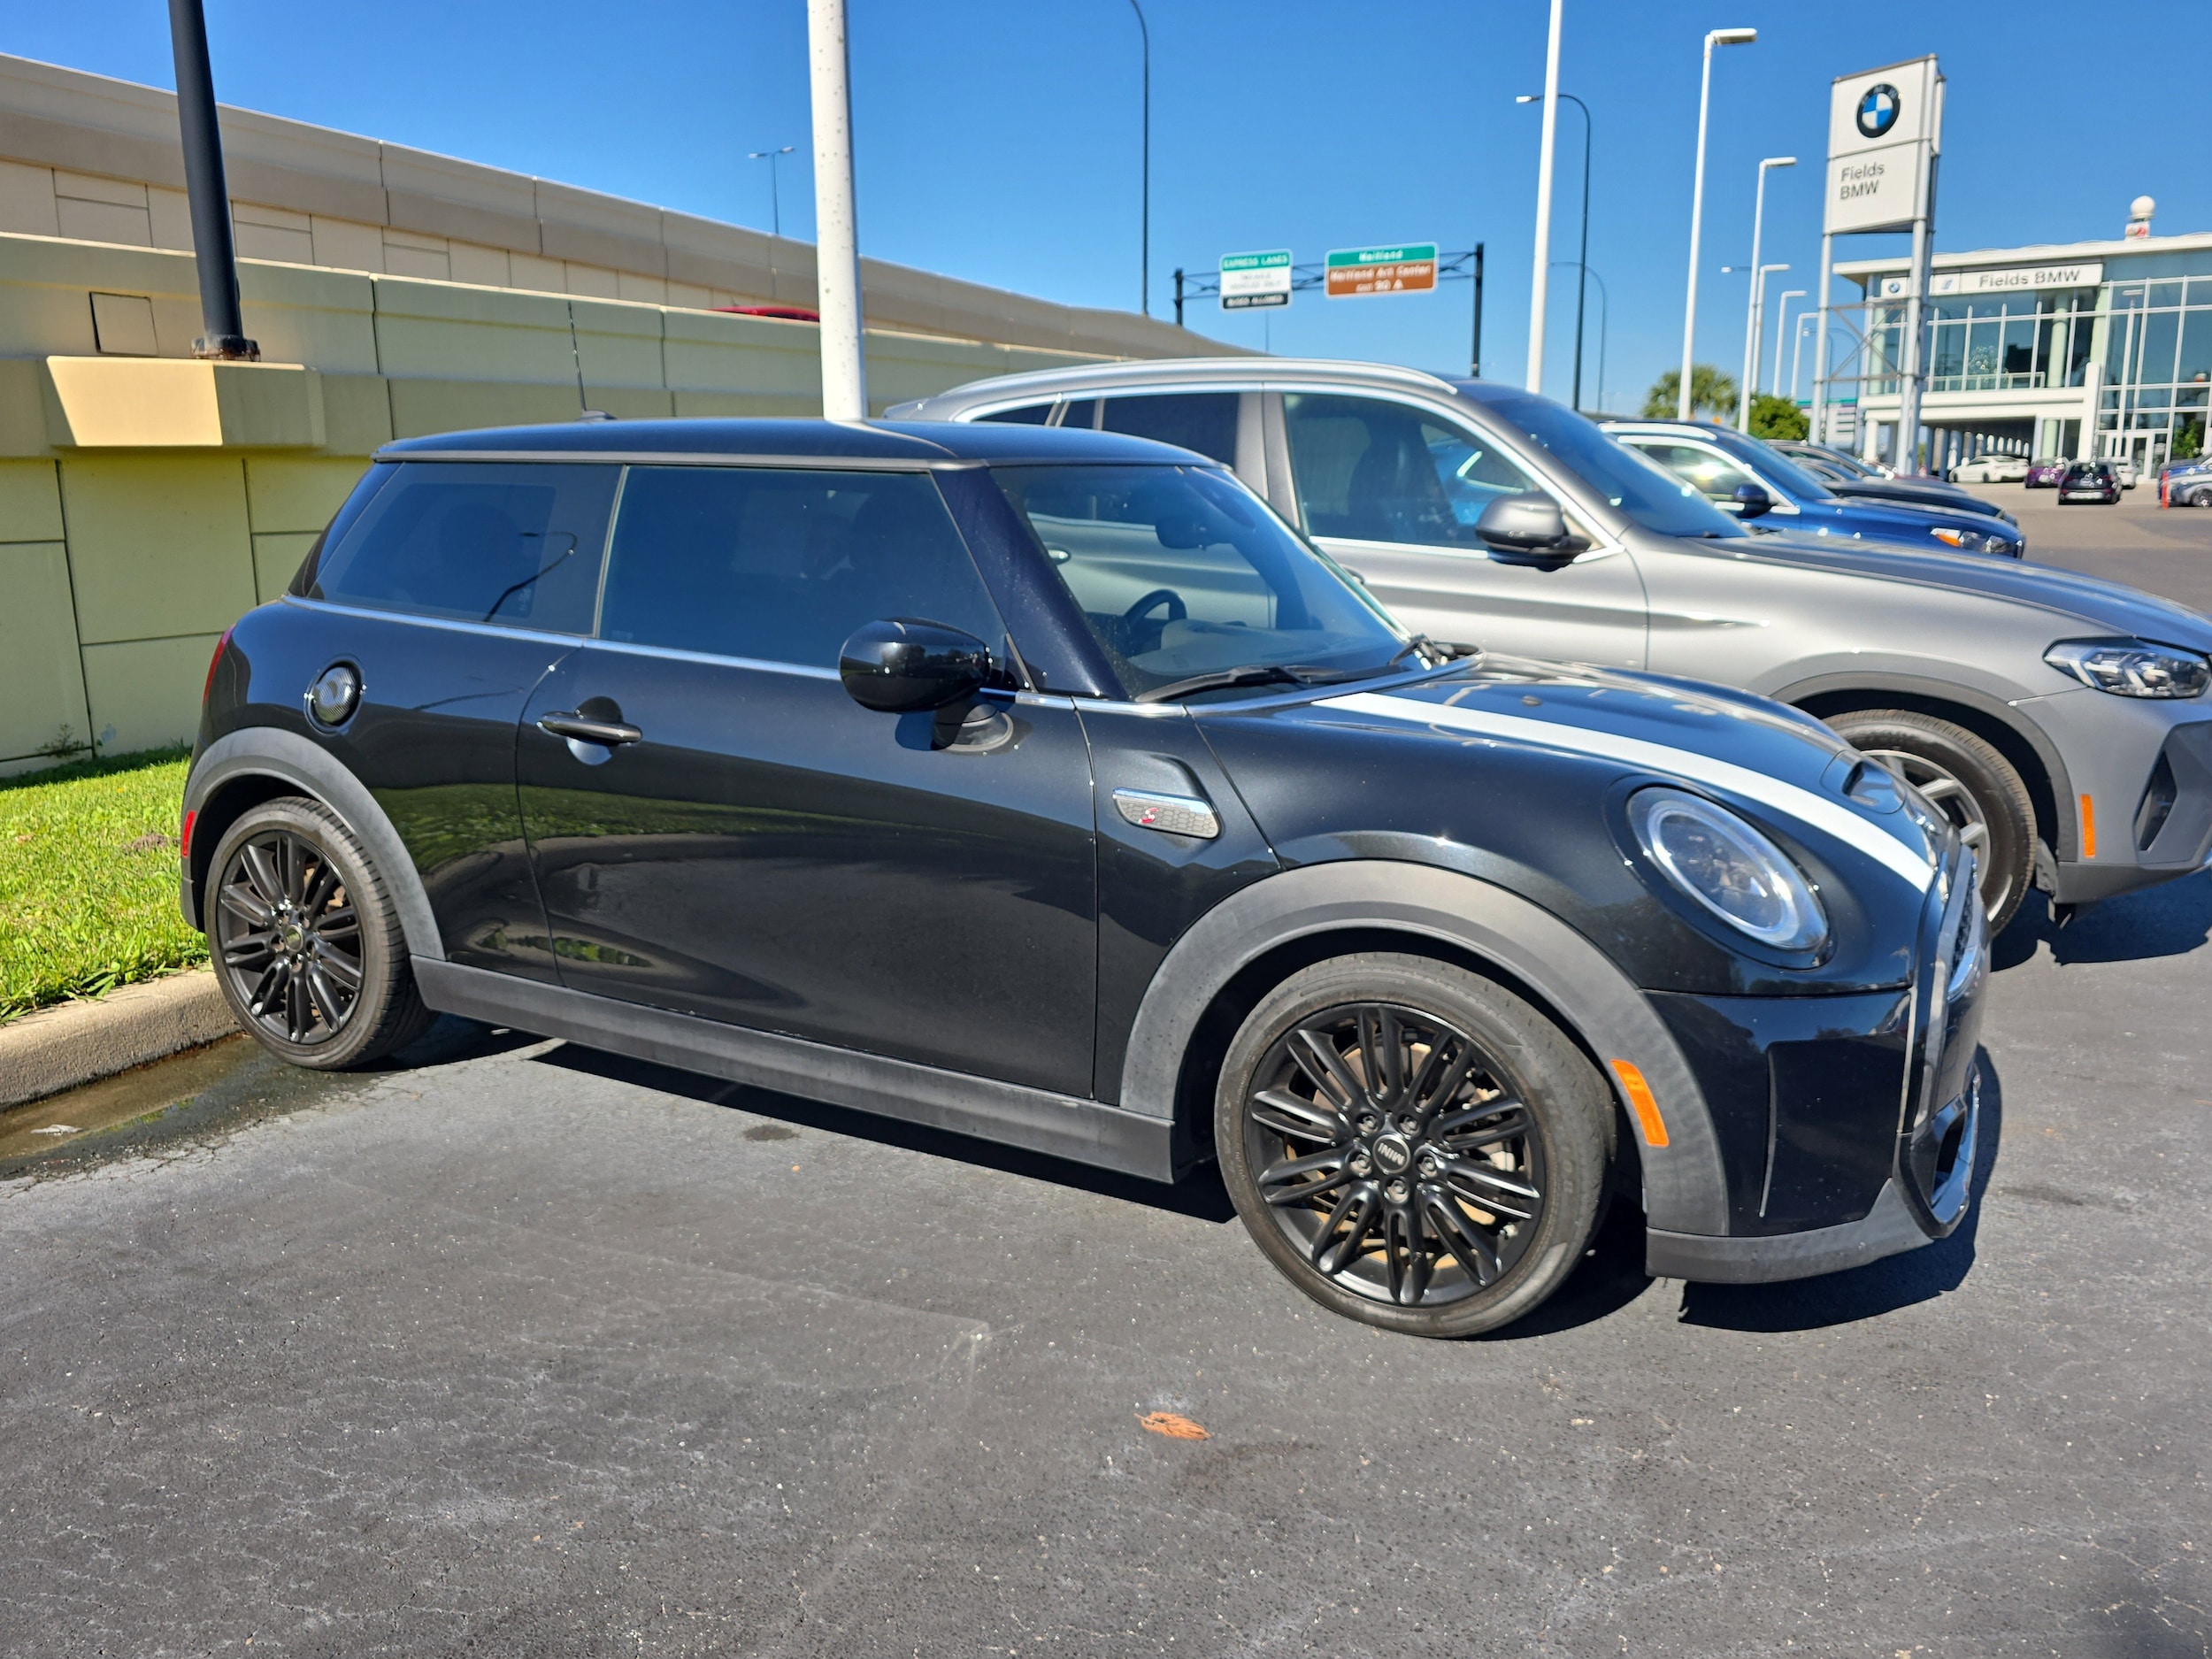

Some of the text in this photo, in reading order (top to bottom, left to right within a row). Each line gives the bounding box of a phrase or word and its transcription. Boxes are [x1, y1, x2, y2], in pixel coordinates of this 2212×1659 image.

[1841, 162, 1885, 181] Fields
[1839, 180, 1879, 200] BMW
[1359, 250, 1403, 262] Maitland
[1329, 267, 1375, 282] Maitland
[1395, 265, 1432, 278] Center
[1978, 268, 2081, 288] Fields BMW
[1378, 1142, 1405, 1165] MINI
